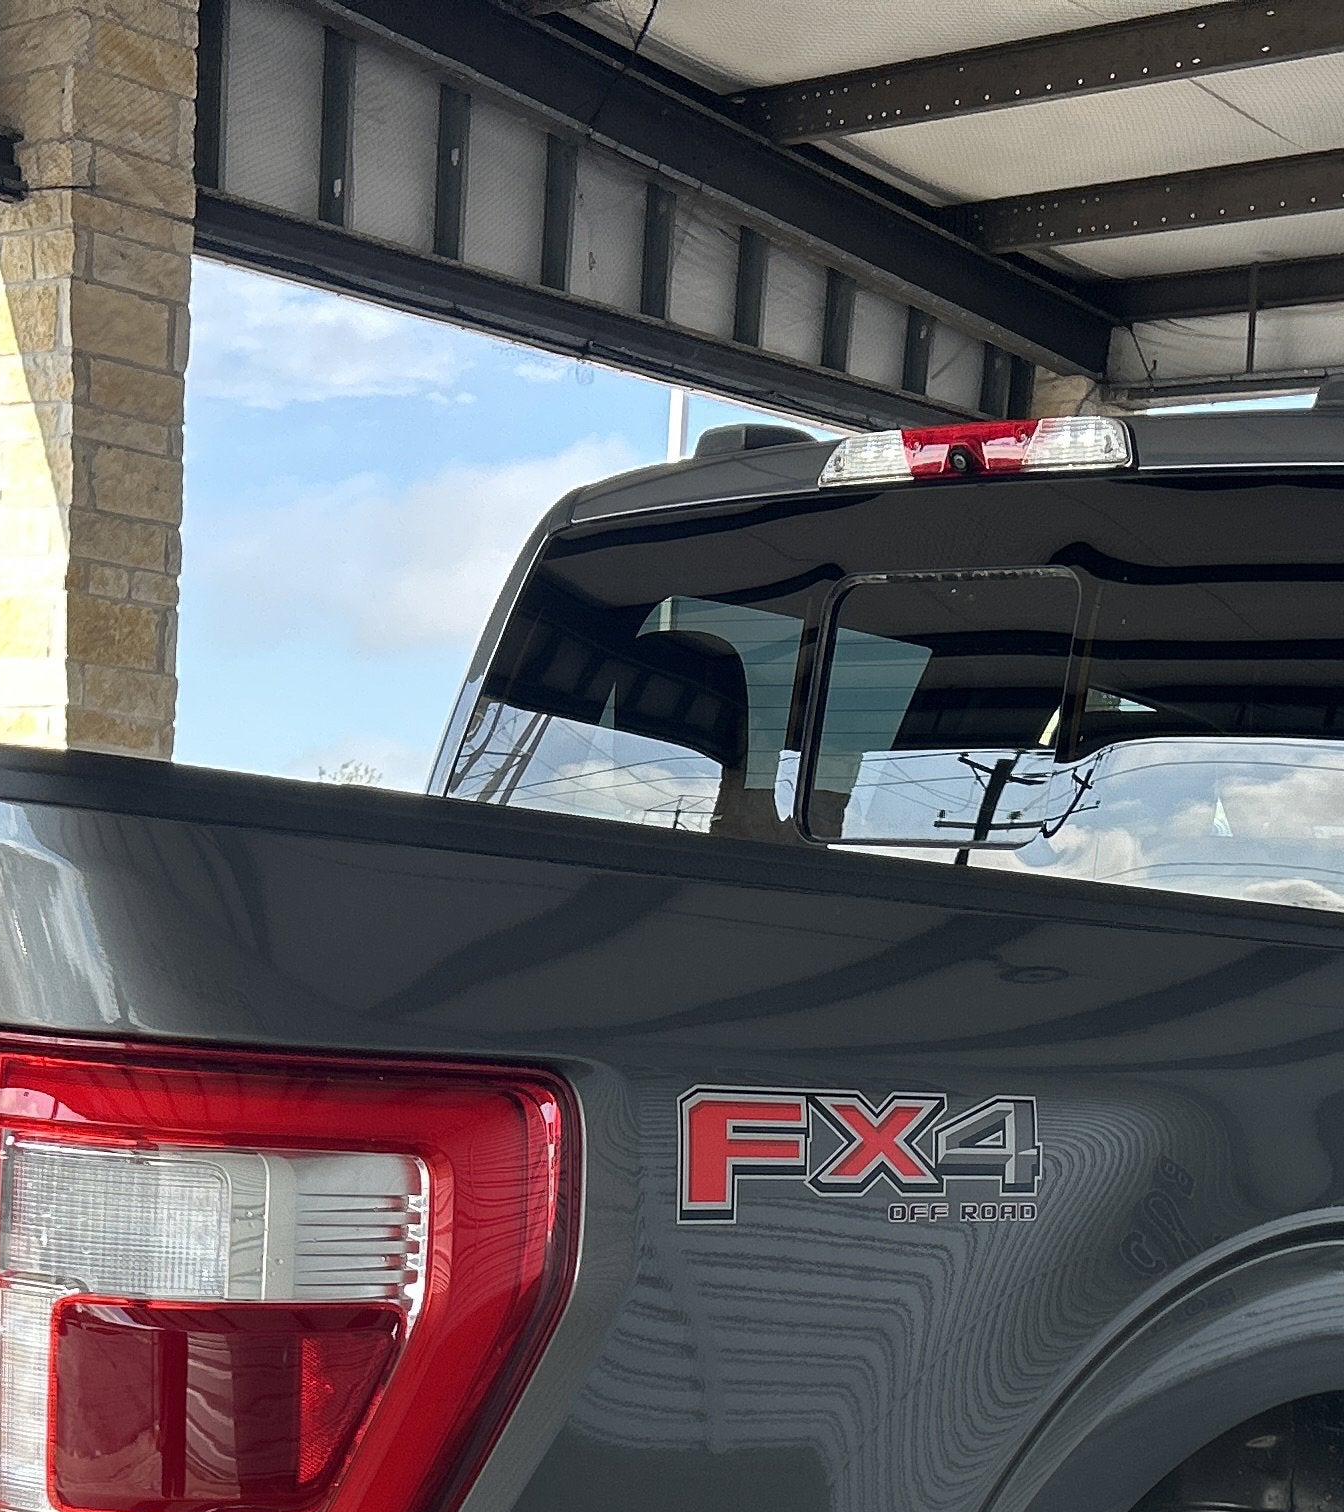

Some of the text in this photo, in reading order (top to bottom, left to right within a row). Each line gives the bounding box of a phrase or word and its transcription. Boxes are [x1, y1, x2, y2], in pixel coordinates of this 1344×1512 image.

[677, 1084, 1042, 1224] FX4
[888, 1202, 1038, 1222] OFF ROAD
